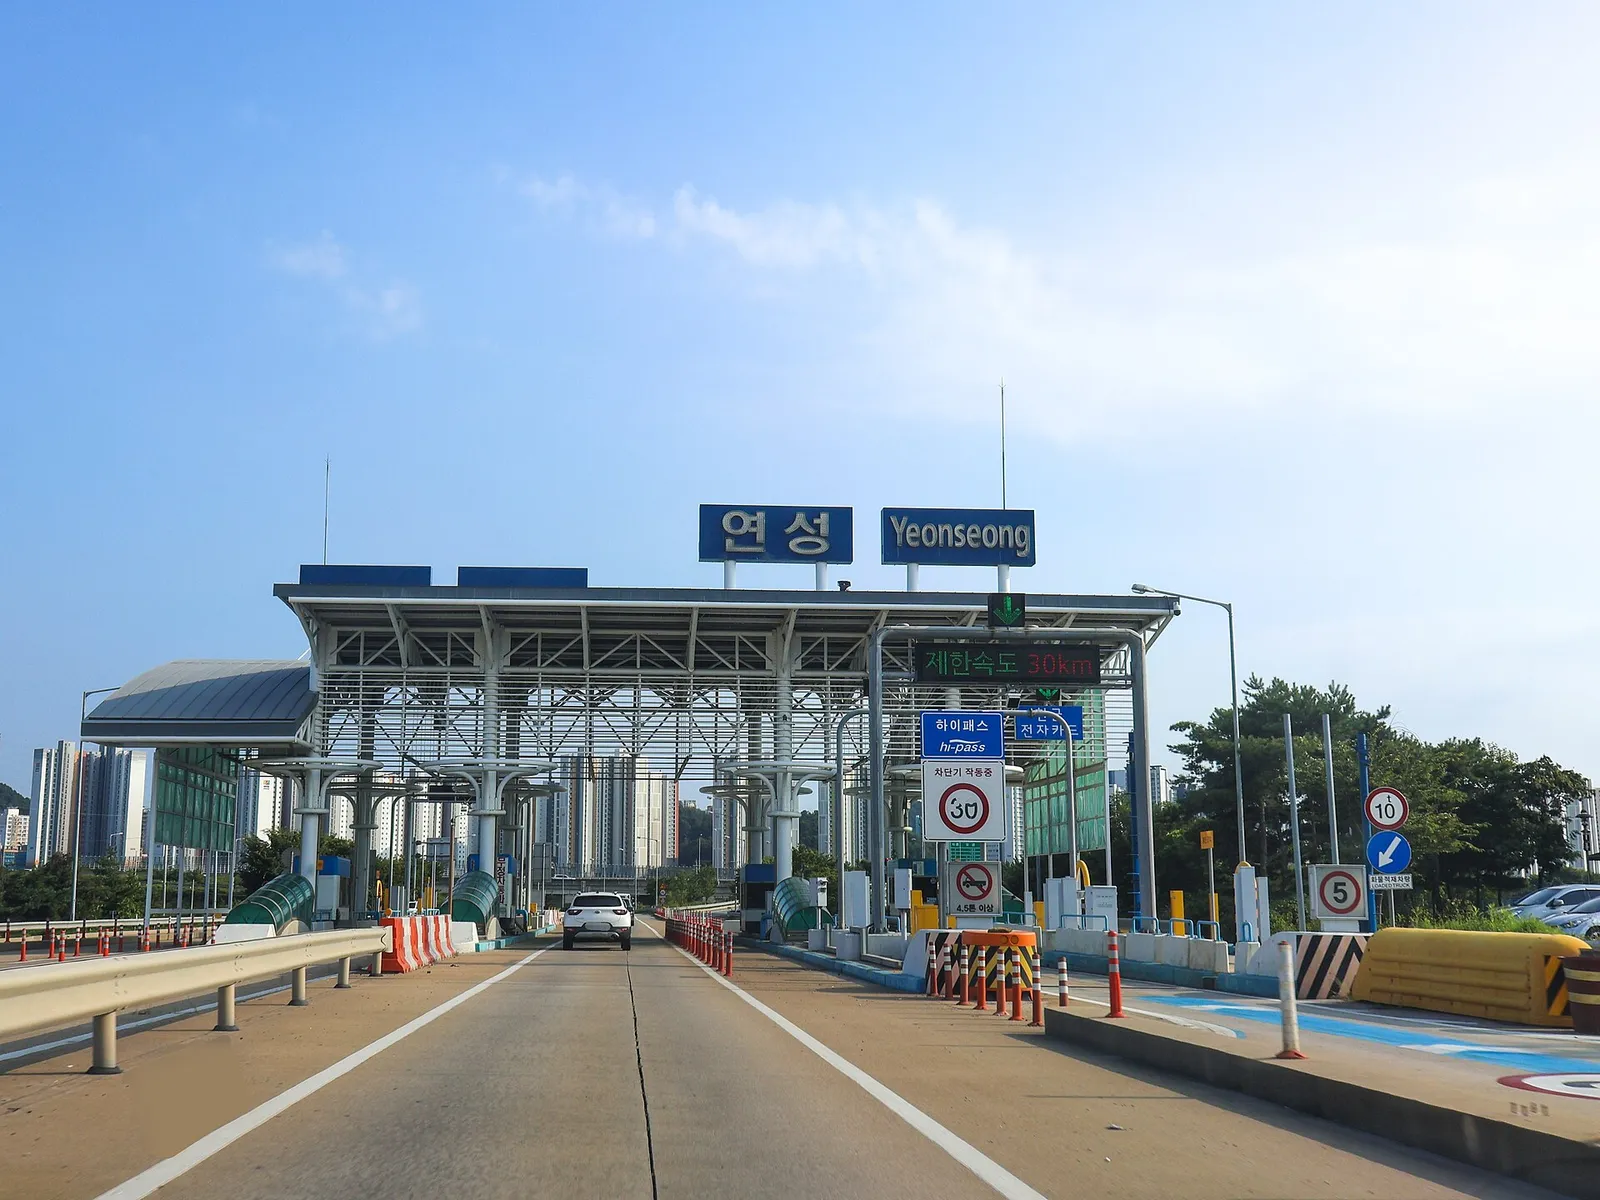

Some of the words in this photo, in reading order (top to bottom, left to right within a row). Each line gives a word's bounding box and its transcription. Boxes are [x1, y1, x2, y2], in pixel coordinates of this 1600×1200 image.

[890, 515, 1030, 557] Yeonseong
[925, 650, 1019, 676] 제한속도
[1027, 653, 1093, 675] 30km
[935, 718, 989, 732] 하이패스
[939, 741, 986, 754] hi-pass
[934, 767, 962, 777] 차단기
[965, 767, 993, 777] 작동중
[950, 797, 978, 820] 30
[1375, 803, 1395, 819] 10
[1333, 881, 1348, 904] 5
[956, 904, 977, 912] 4.5톤
[978, 904, 994, 912] 이상
